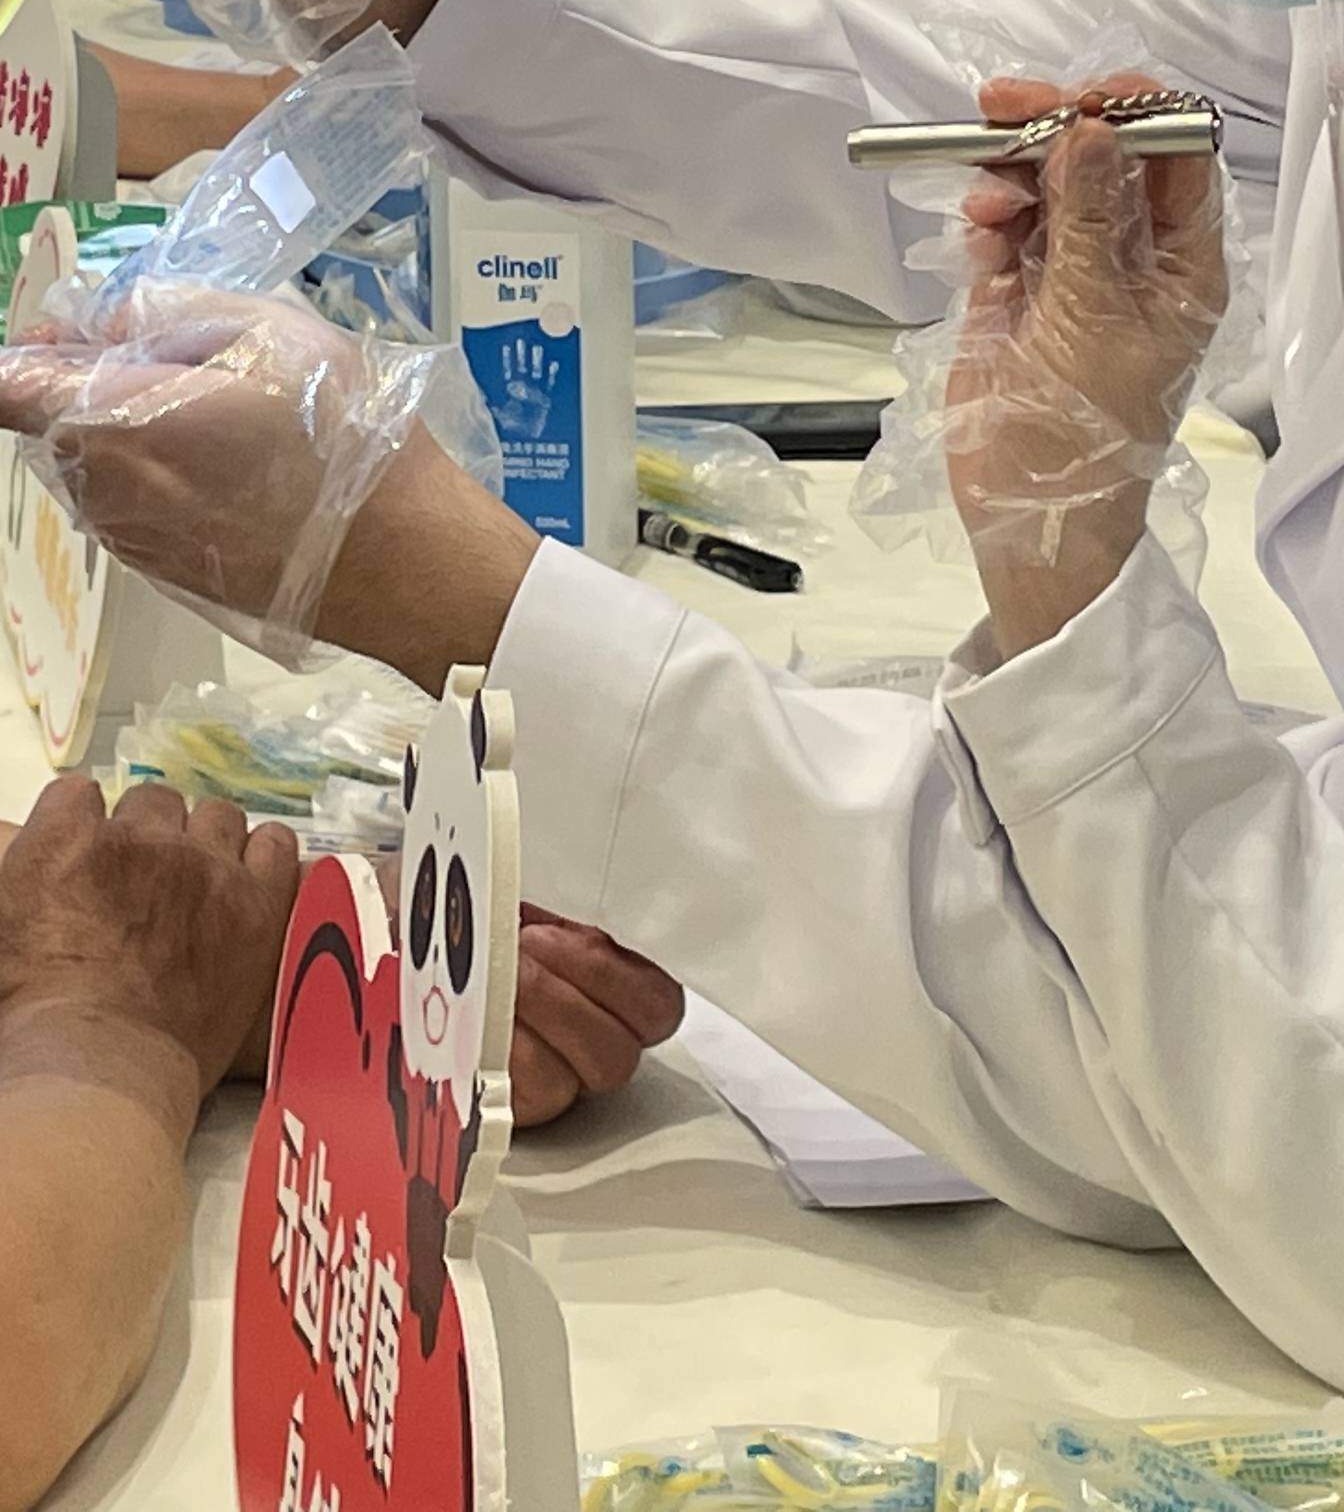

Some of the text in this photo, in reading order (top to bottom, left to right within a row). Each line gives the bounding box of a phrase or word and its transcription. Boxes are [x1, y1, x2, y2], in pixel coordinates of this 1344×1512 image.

[477, 254, 558, 280] clinell
[271, 1108, 404, 1491] 牙齿健康
